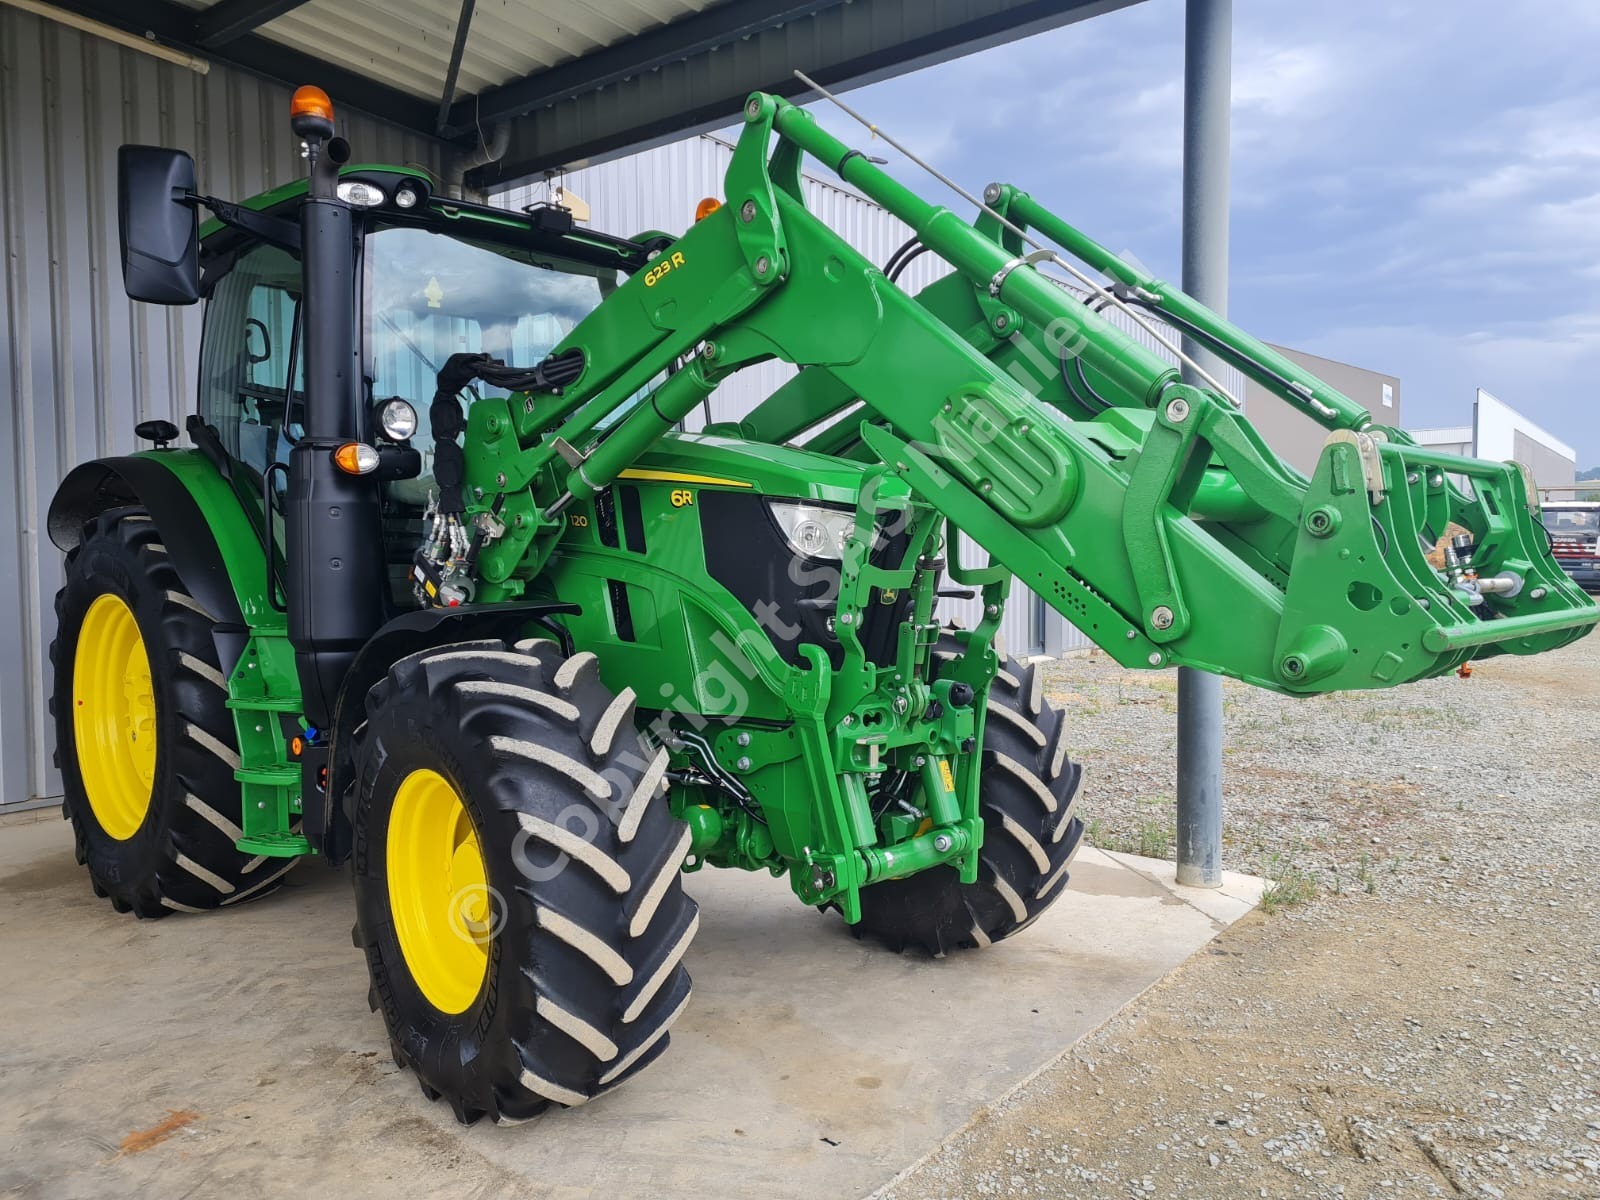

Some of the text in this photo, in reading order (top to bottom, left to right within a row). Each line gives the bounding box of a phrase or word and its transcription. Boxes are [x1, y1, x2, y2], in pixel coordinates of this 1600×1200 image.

[644, 251, 687, 287] 623 R
[670, 489, 694, 508] 6R
